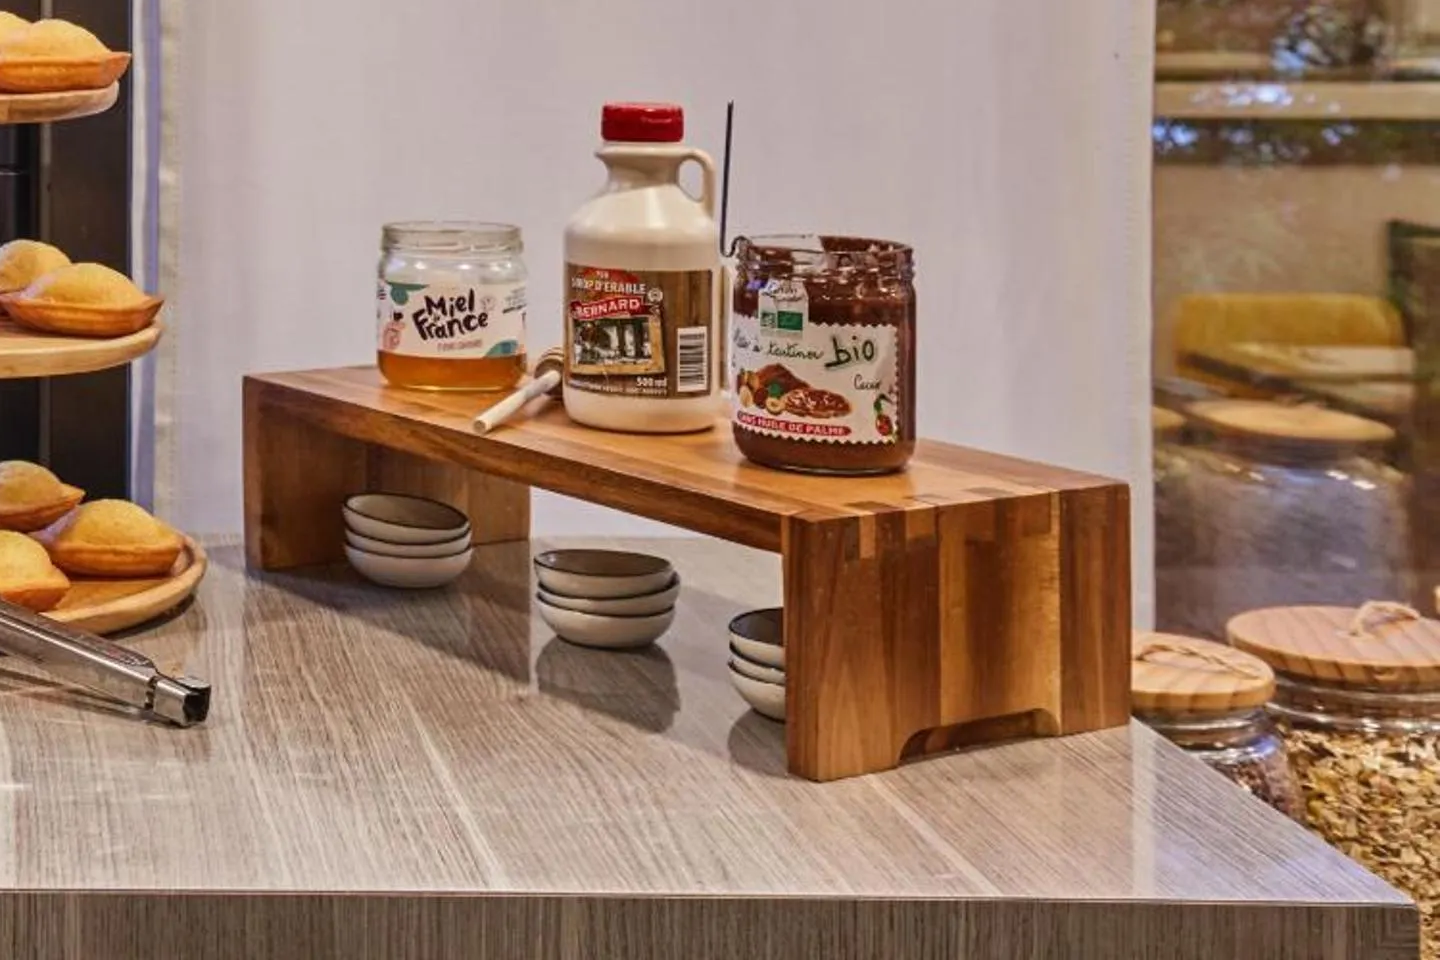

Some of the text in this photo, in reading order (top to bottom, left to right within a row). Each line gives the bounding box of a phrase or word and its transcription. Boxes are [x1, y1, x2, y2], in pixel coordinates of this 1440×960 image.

[424, 288, 475, 317] Miel
[573, 298, 641, 318] BERNARD
[412, 311, 489, 341] France
[824, 335, 875, 368] bio
